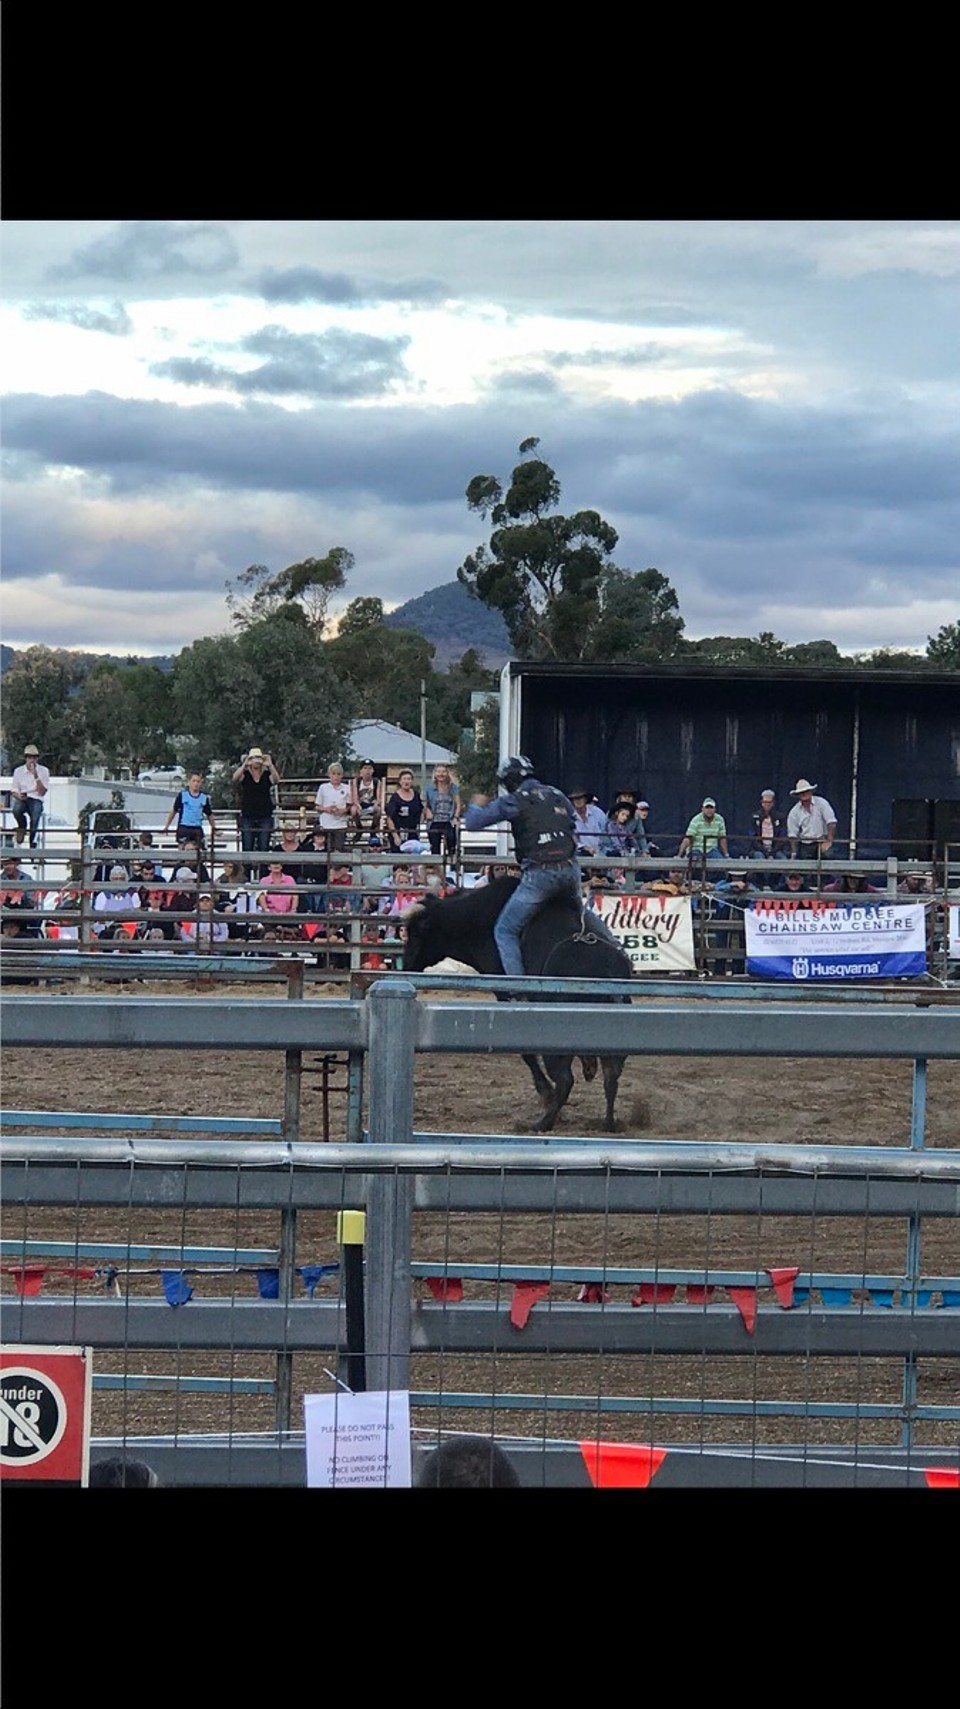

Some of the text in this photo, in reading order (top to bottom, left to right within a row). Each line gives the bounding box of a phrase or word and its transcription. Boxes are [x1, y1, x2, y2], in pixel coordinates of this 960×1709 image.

[599, 900, 680, 943] ddlery
[775, 909, 895, 922] BILLS MUDGEE
[758, 918, 913, 932] CHAINSAW CENTRE
[614, 935, 658, 949] 58
[630, 953, 660, 961] GEE
[811, 962, 879, 977] Husqvarna
[0, 1385, 43, 1400] under
[0, 1401, 40, 1448] 18
[348, 1424, 359, 1432] DO
[341, 1455, 376, 1463] CLIMBING
[350, 1465, 376, 1473] UNDER
